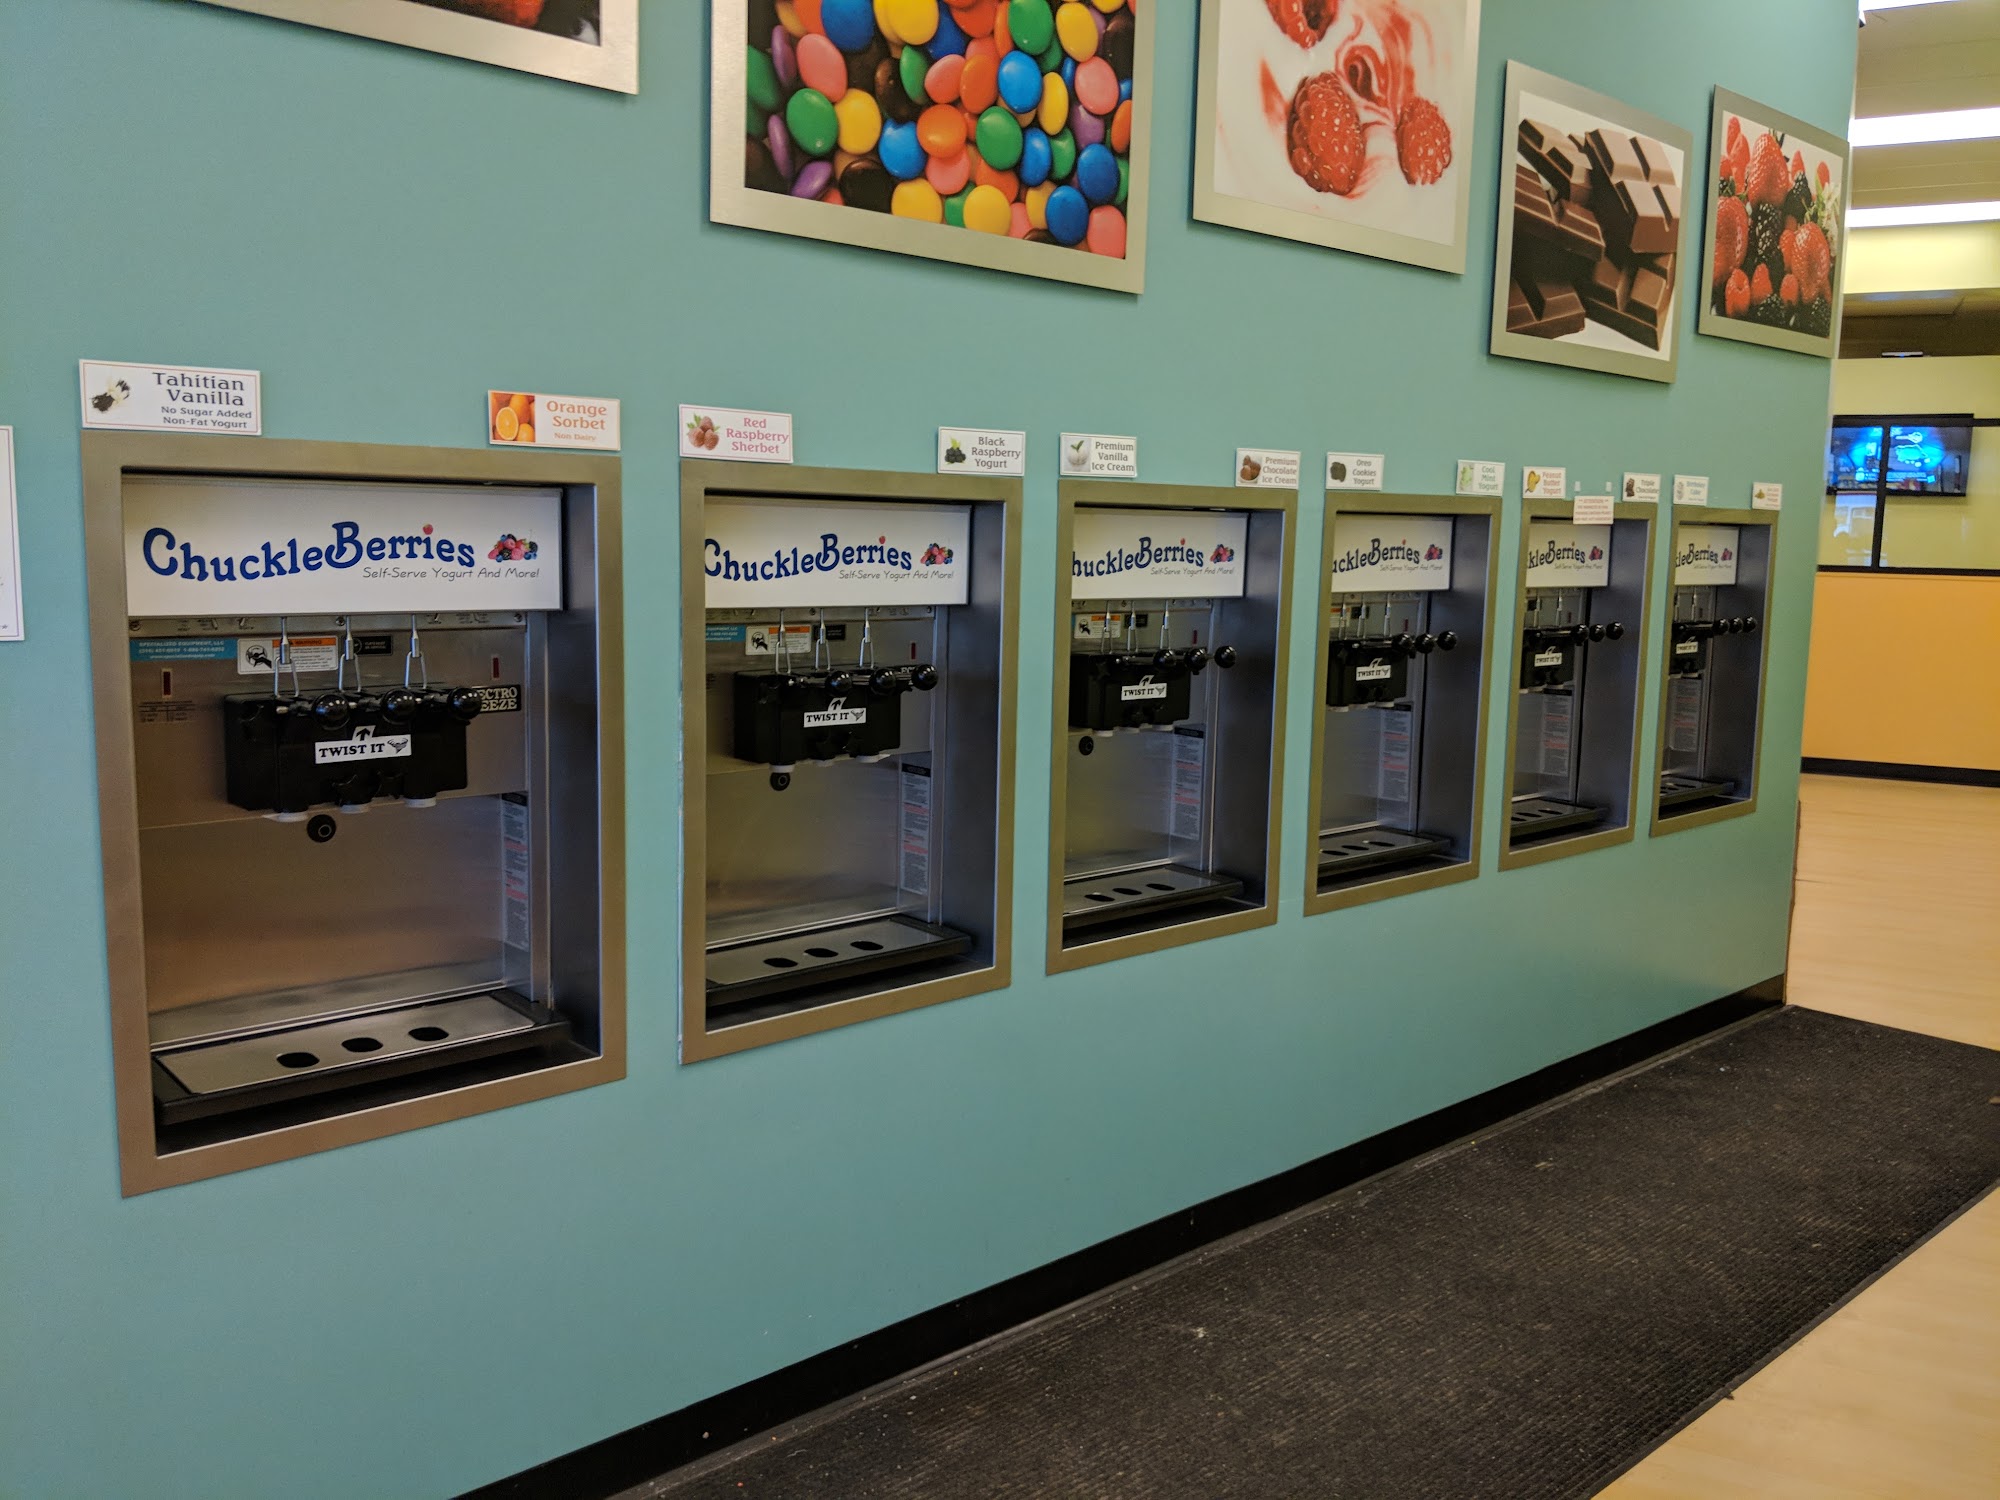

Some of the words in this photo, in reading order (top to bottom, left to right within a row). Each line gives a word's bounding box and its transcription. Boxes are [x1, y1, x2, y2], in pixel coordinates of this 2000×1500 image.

[152, 372, 244, 391] Tahitian
[167, 389, 243, 406] Vanilla
[162, 406, 176, 414] No
[181, 407, 213, 417] Sugar
[217, 410, 252, 418] Added
[547, 400, 607, 417] Orange
[164, 417, 208, 426] Non-Fat
[211, 420, 247, 428] Yogurt
[553, 416, 605, 430] Sorbet
[744, 418, 766, 428] Red
[574, 434, 596, 442] Dairy
[726, 428, 789, 444] Raspberry
[732, 442, 779, 453] Sherbet
[979, 437, 1005, 447] Black
[1095, 442, 1134, 451] Premium
[972, 447, 1020, 459] Raspberry
[1099, 453, 1128, 461] Vanilla
[975, 459, 1007, 469] Yogurt
[1265, 457, 1297, 466] Premium
[1107, 463, 1134, 472] Cream
[1263, 466, 1297, 475] Chocolate
[1275, 476, 1297, 484] Cream
[1354, 478, 1374, 486] Yogurt
[143, 521, 476, 582] ChuckleBerries
[1072, 537, 1204, 577] huckleBerries
[704, 534, 912, 582] ChuckleBerries
[362, 567, 427, 578] Self-Serve
[432, 568, 472, 581] Yogurt
[478, 568, 501, 578] And
[506, 568, 540, 578] More!
[839, 570, 880, 579] Self-Serve
[884, 570, 910, 582] Yogurt
[913, 570, 928, 579] And
[931, 570, 953, 579] More!
[1183, 568, 1202, 577] Yogurt
[477, 687, 518, 700] ECTRO
[480, 698, 517, 712] EEZE
[806, 713, 837, 722] TWIST
[840, 712, 849, 720] IT
[319, 745, 366, 758] TWIST
[371, 743, 385, 753] IT
